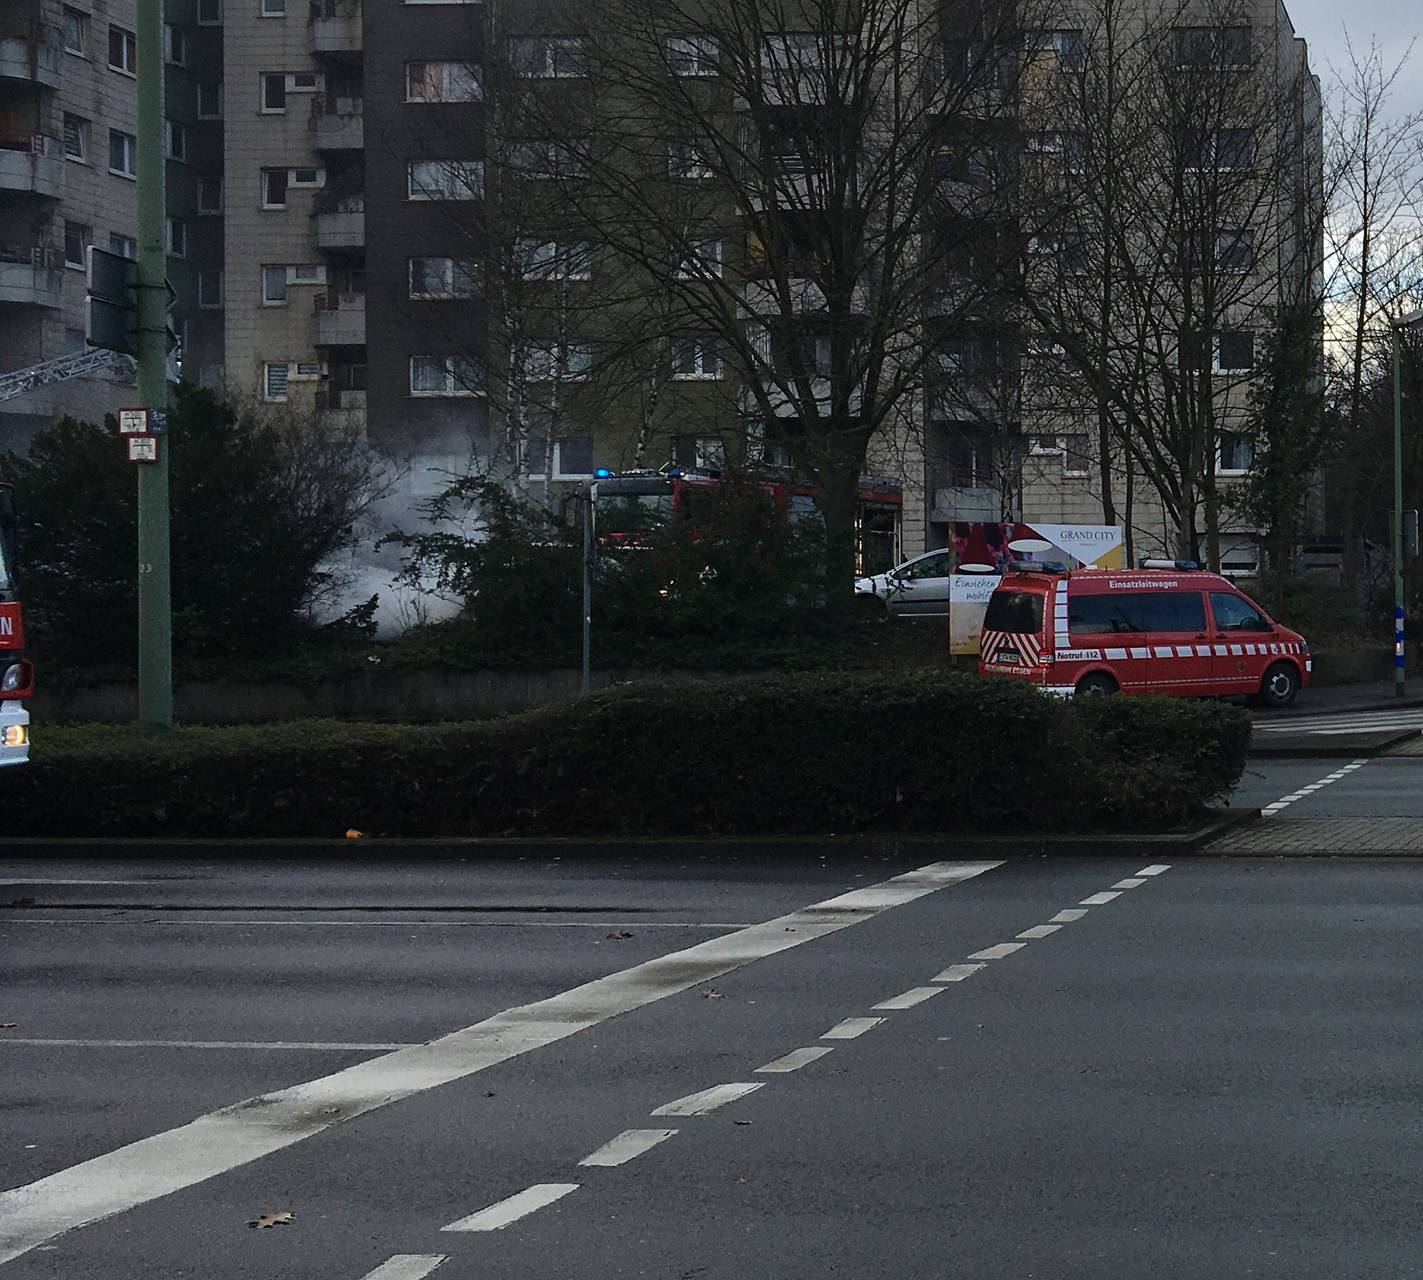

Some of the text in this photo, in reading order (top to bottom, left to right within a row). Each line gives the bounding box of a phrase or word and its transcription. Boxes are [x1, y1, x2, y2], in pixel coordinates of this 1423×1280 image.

[1060, 530, 1118, 540] GRAND CITY
[1109, 580, 1178, 589] Einsatzleitwagen
[1057, 650, 1098, 660] Notruf 112
